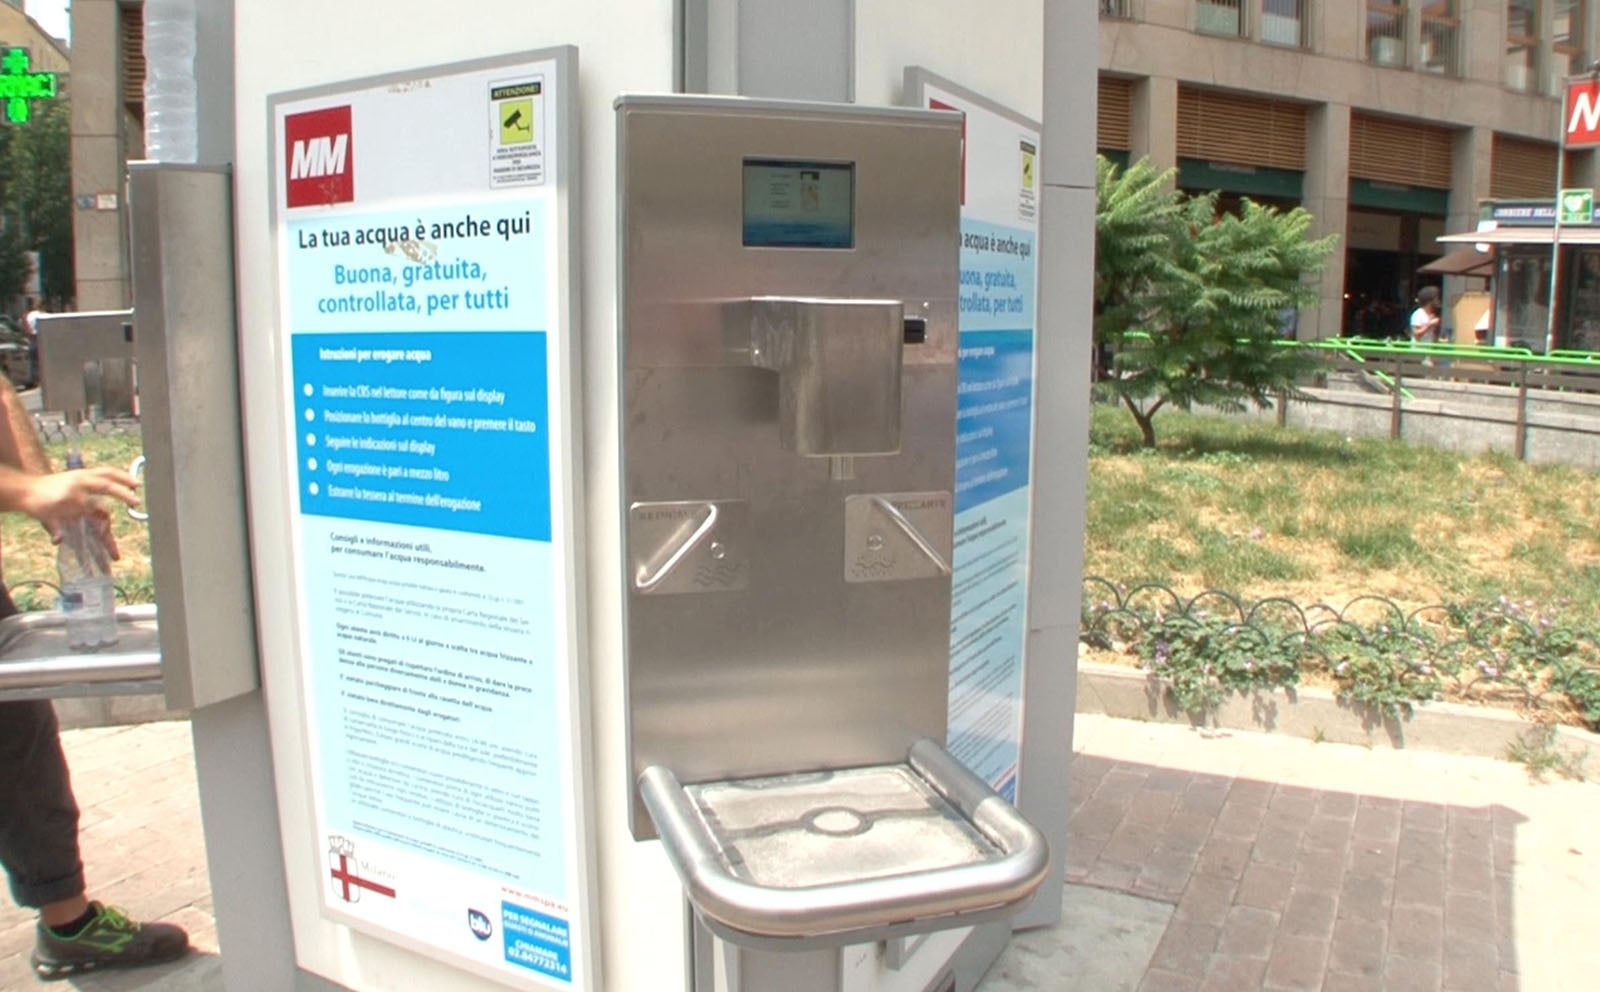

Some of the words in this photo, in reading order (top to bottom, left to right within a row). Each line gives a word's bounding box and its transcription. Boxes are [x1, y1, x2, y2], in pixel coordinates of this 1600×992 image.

[290, 134, 348, 181] MM
[298, 229, 318, 249] La
[322, 230, 350, 247] tua
[355, 226, 409, 249] acqua
[415, 219, 425, 240] è
[431, 215, 490, 239] anche
[497, 211, 530, 241] qui
[334, 264, 397, 285] Buona,
[402, 258, 487, 287] gratuita,
[318, 290, 421, 313] controllata,
[427, 295, 459, 316] per
[465, 287, 509, 309] tutti
[331, 544, 342, 554] per
[366, 535, 413, 550] informazioni
